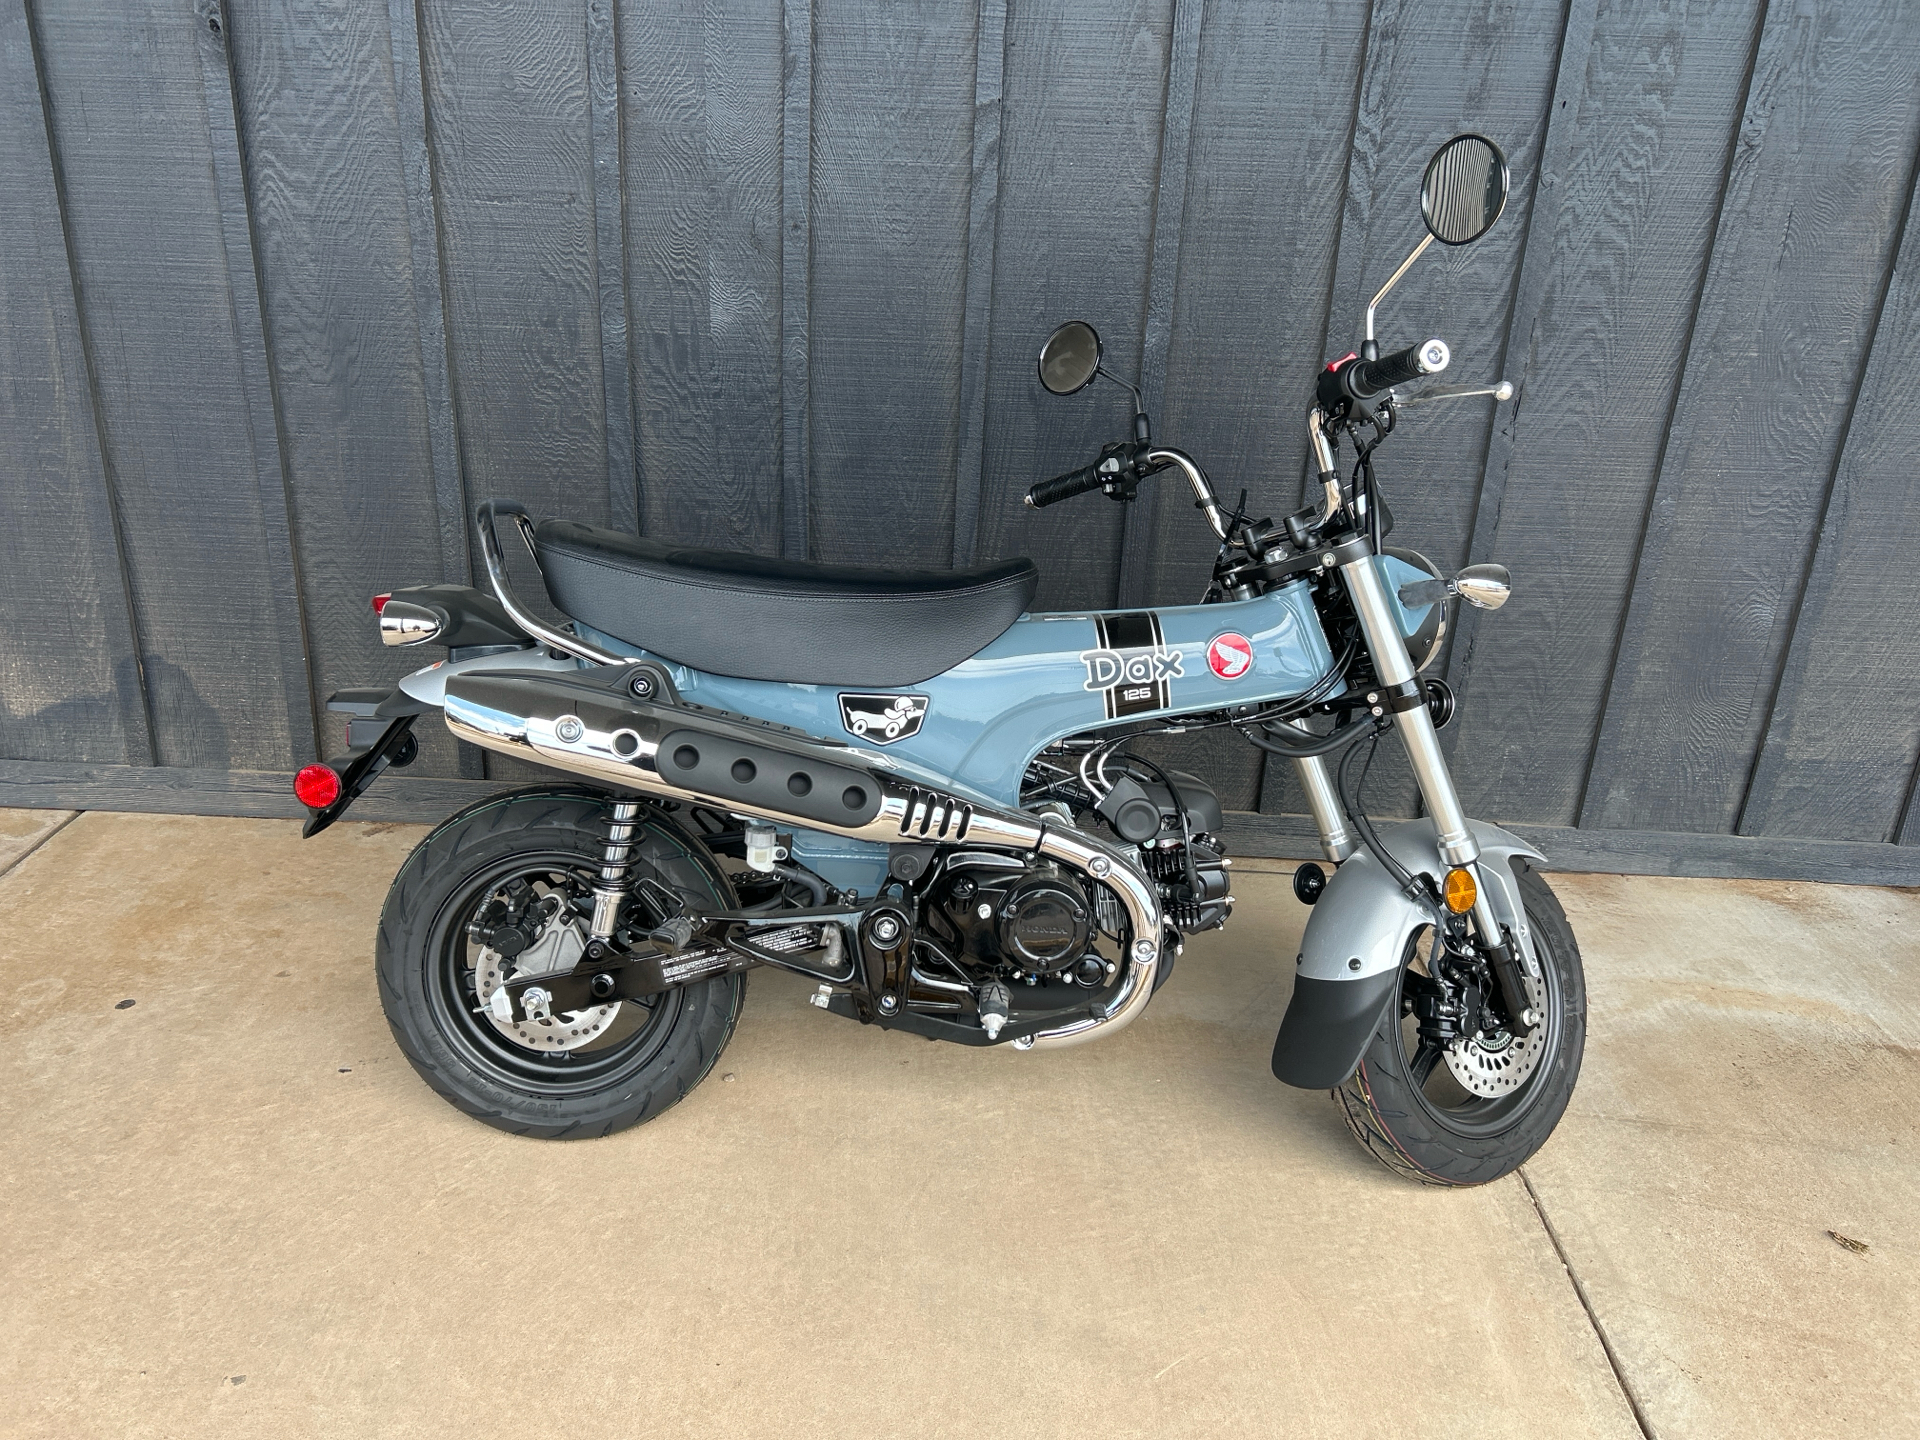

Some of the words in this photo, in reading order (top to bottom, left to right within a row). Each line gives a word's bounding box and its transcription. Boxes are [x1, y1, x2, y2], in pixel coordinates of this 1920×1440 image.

[1081, 649, 1184, 691] Dax
[1123, 687, 1152, 701] 125
[1021, 925, 1068, 935] HONDA
